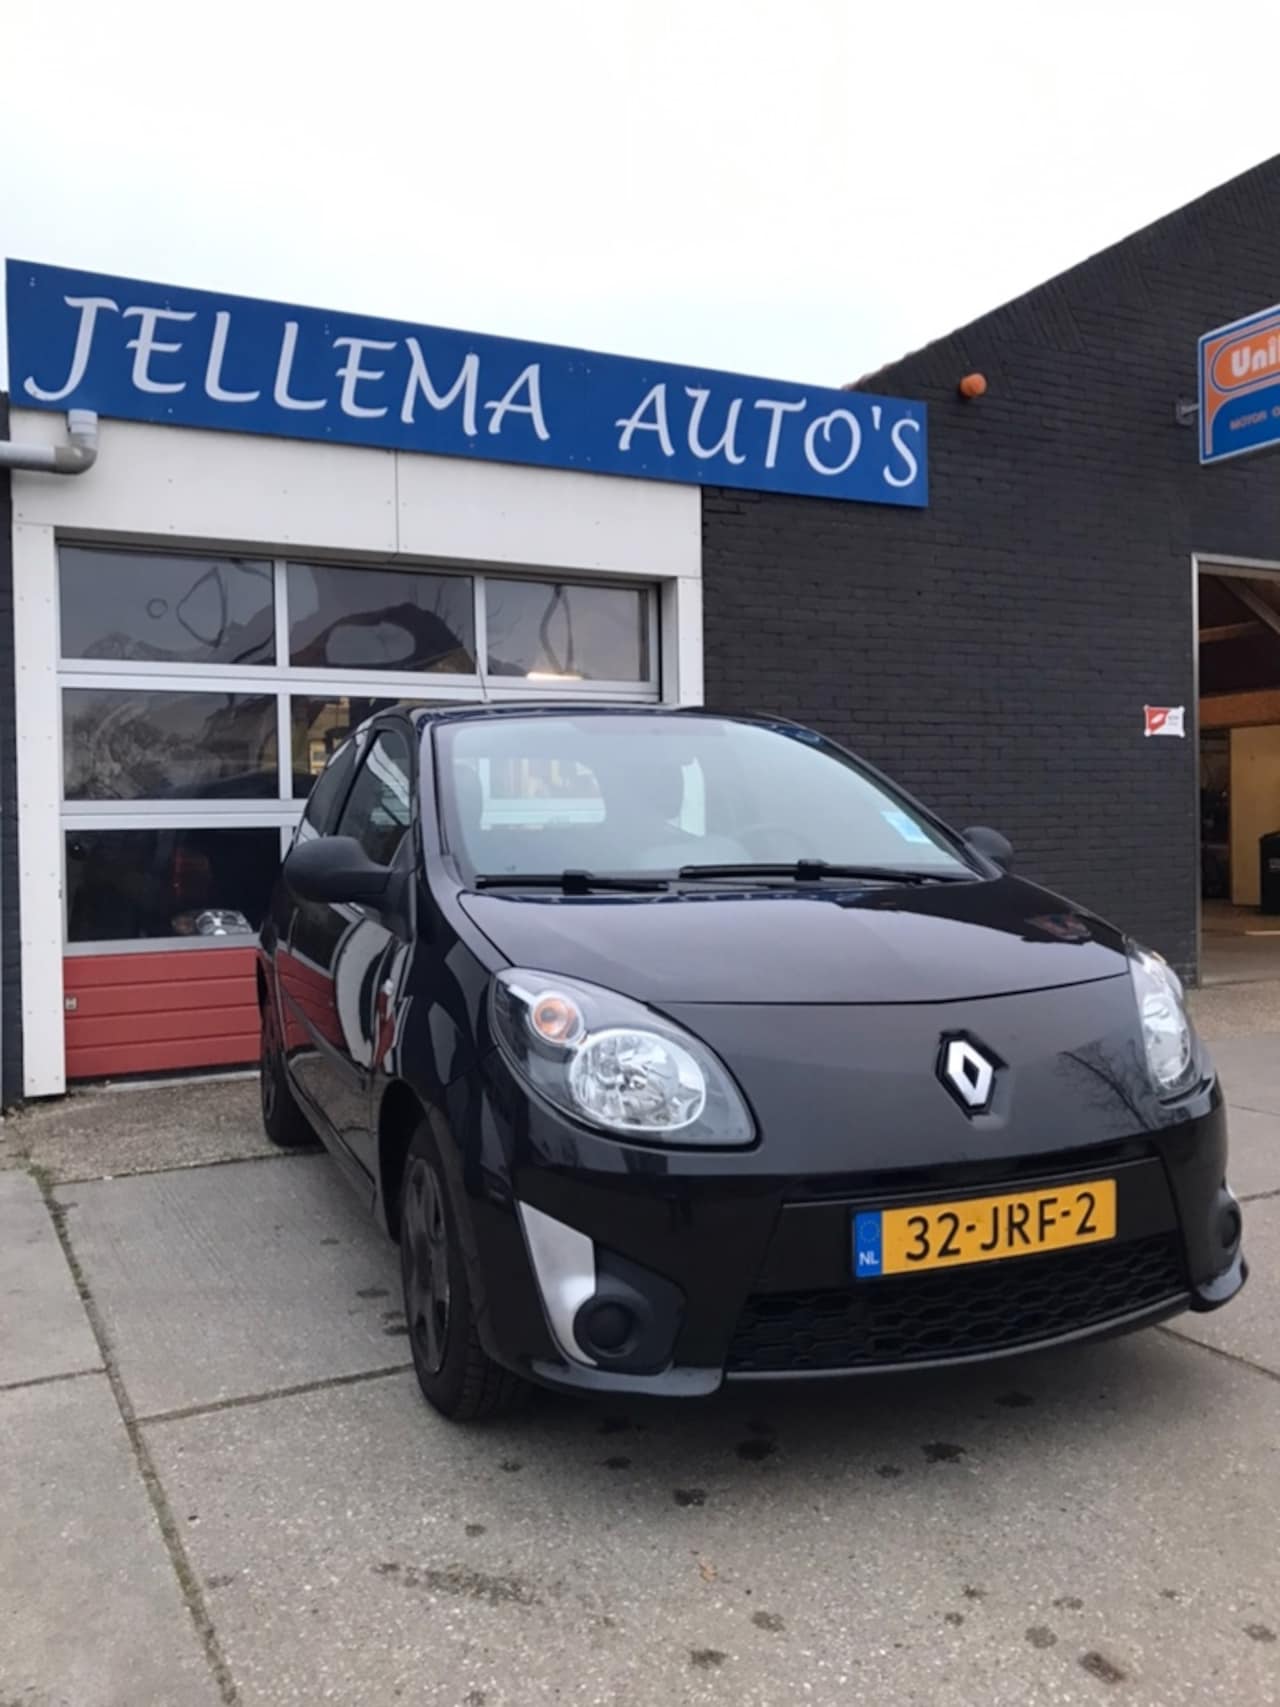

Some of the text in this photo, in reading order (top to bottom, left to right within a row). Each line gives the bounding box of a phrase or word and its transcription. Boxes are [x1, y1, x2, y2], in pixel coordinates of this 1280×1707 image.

[1231, 335, 1280, 377] Uni
[23, 295, 921, 488] JELLEMA AUTO'S
[905, 1191, 1097, 1261] 32-JRF-2
[858, 1251, 880, 1266] NL
